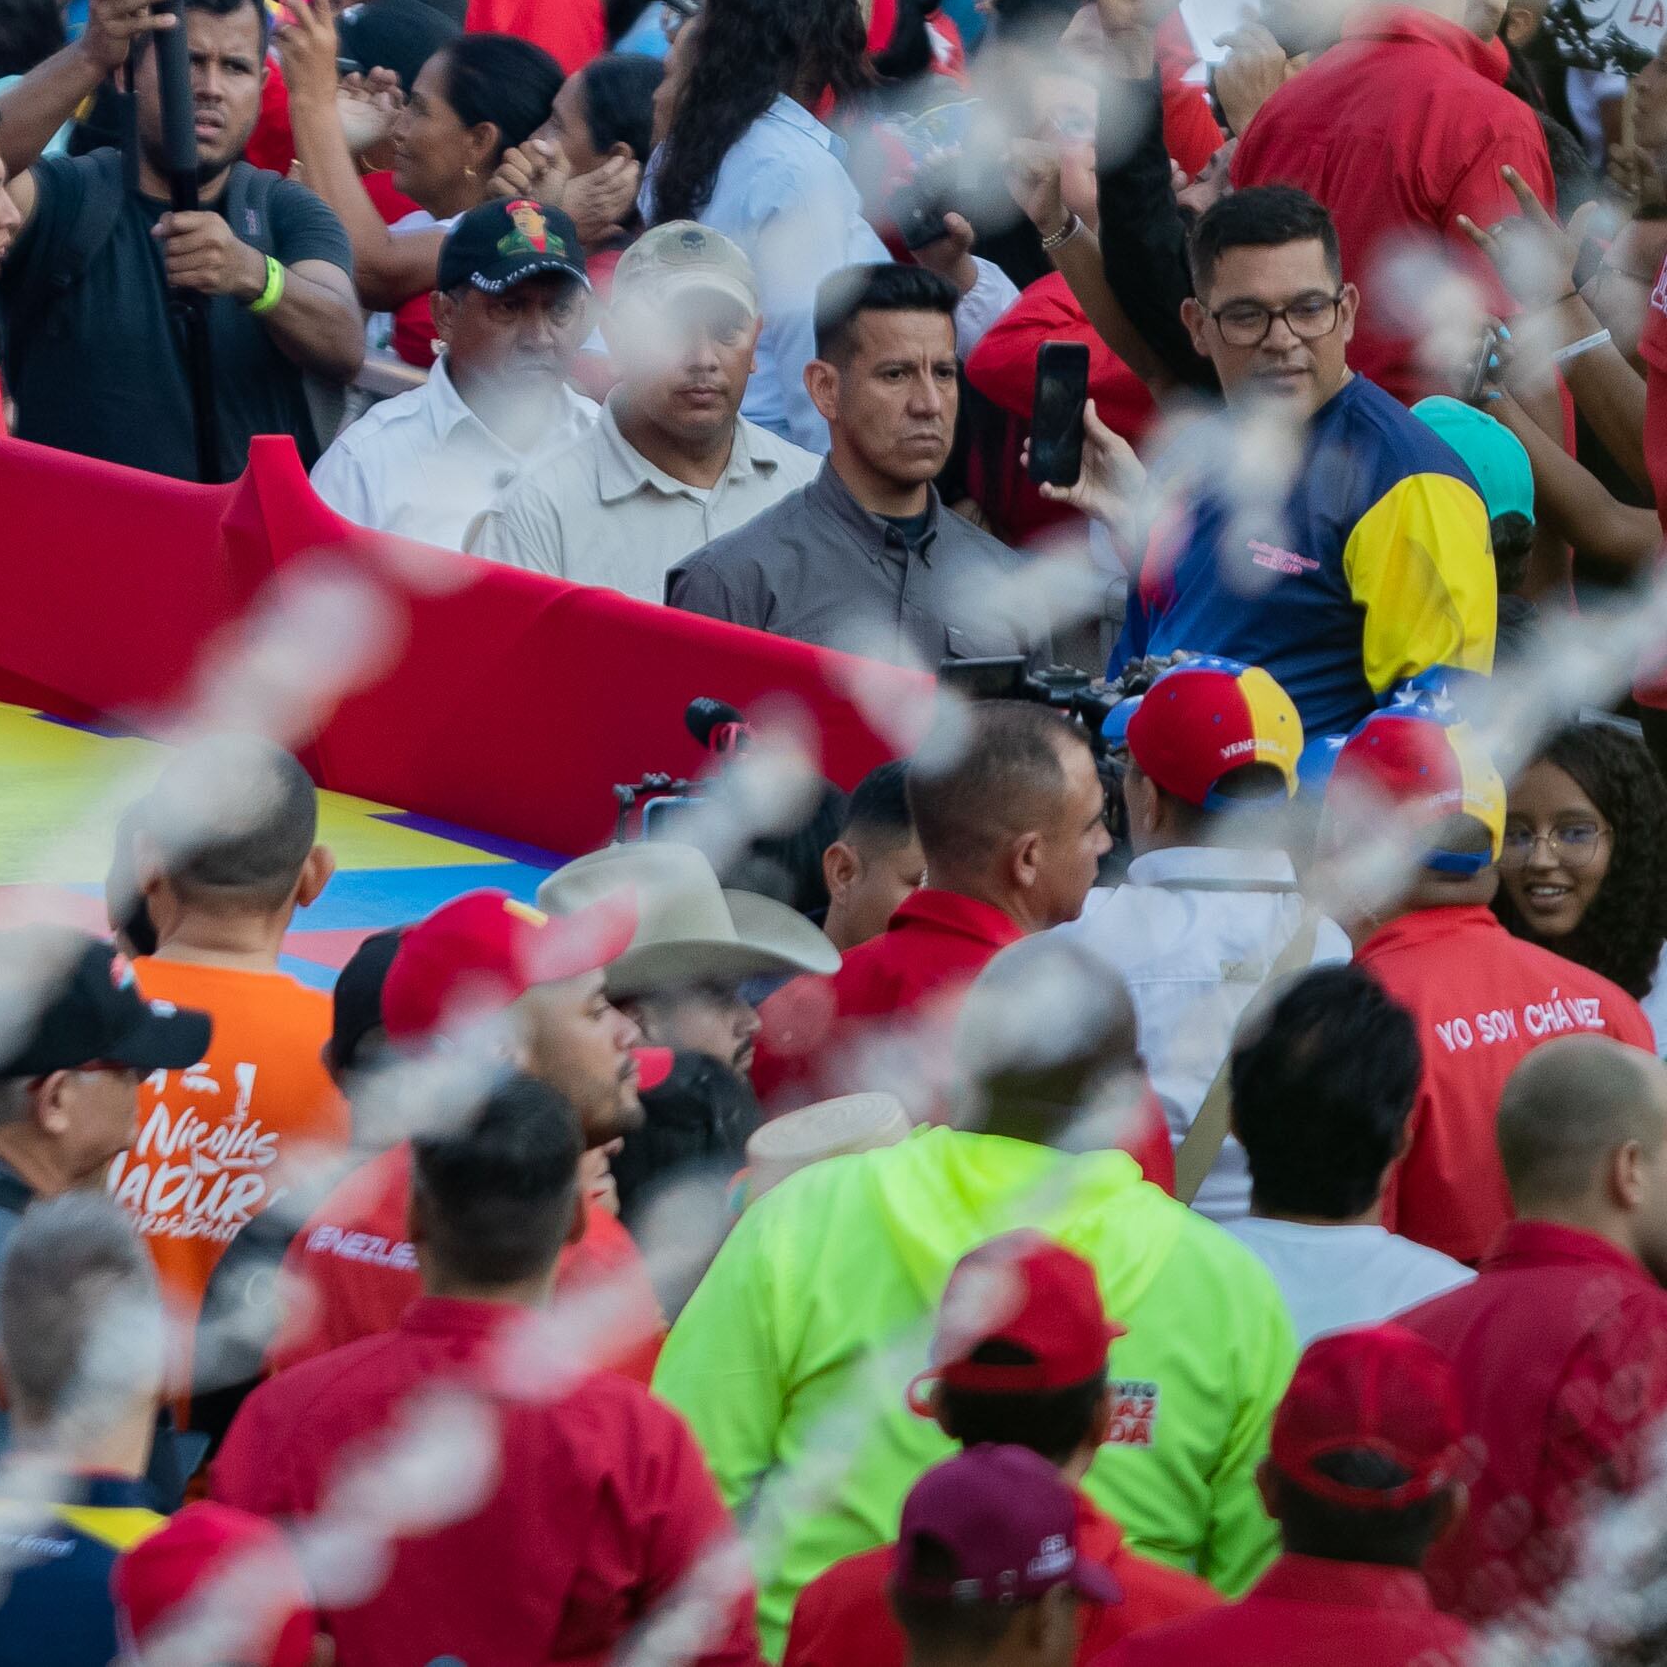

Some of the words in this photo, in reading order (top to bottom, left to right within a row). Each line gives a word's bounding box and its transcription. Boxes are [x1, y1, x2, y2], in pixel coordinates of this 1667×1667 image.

[1435, 1017, 1475, 1053] YO
[1475, 1008, 1519, 1044] SOY
[1523, 986, 1606, 1037] CHÁVEZ
